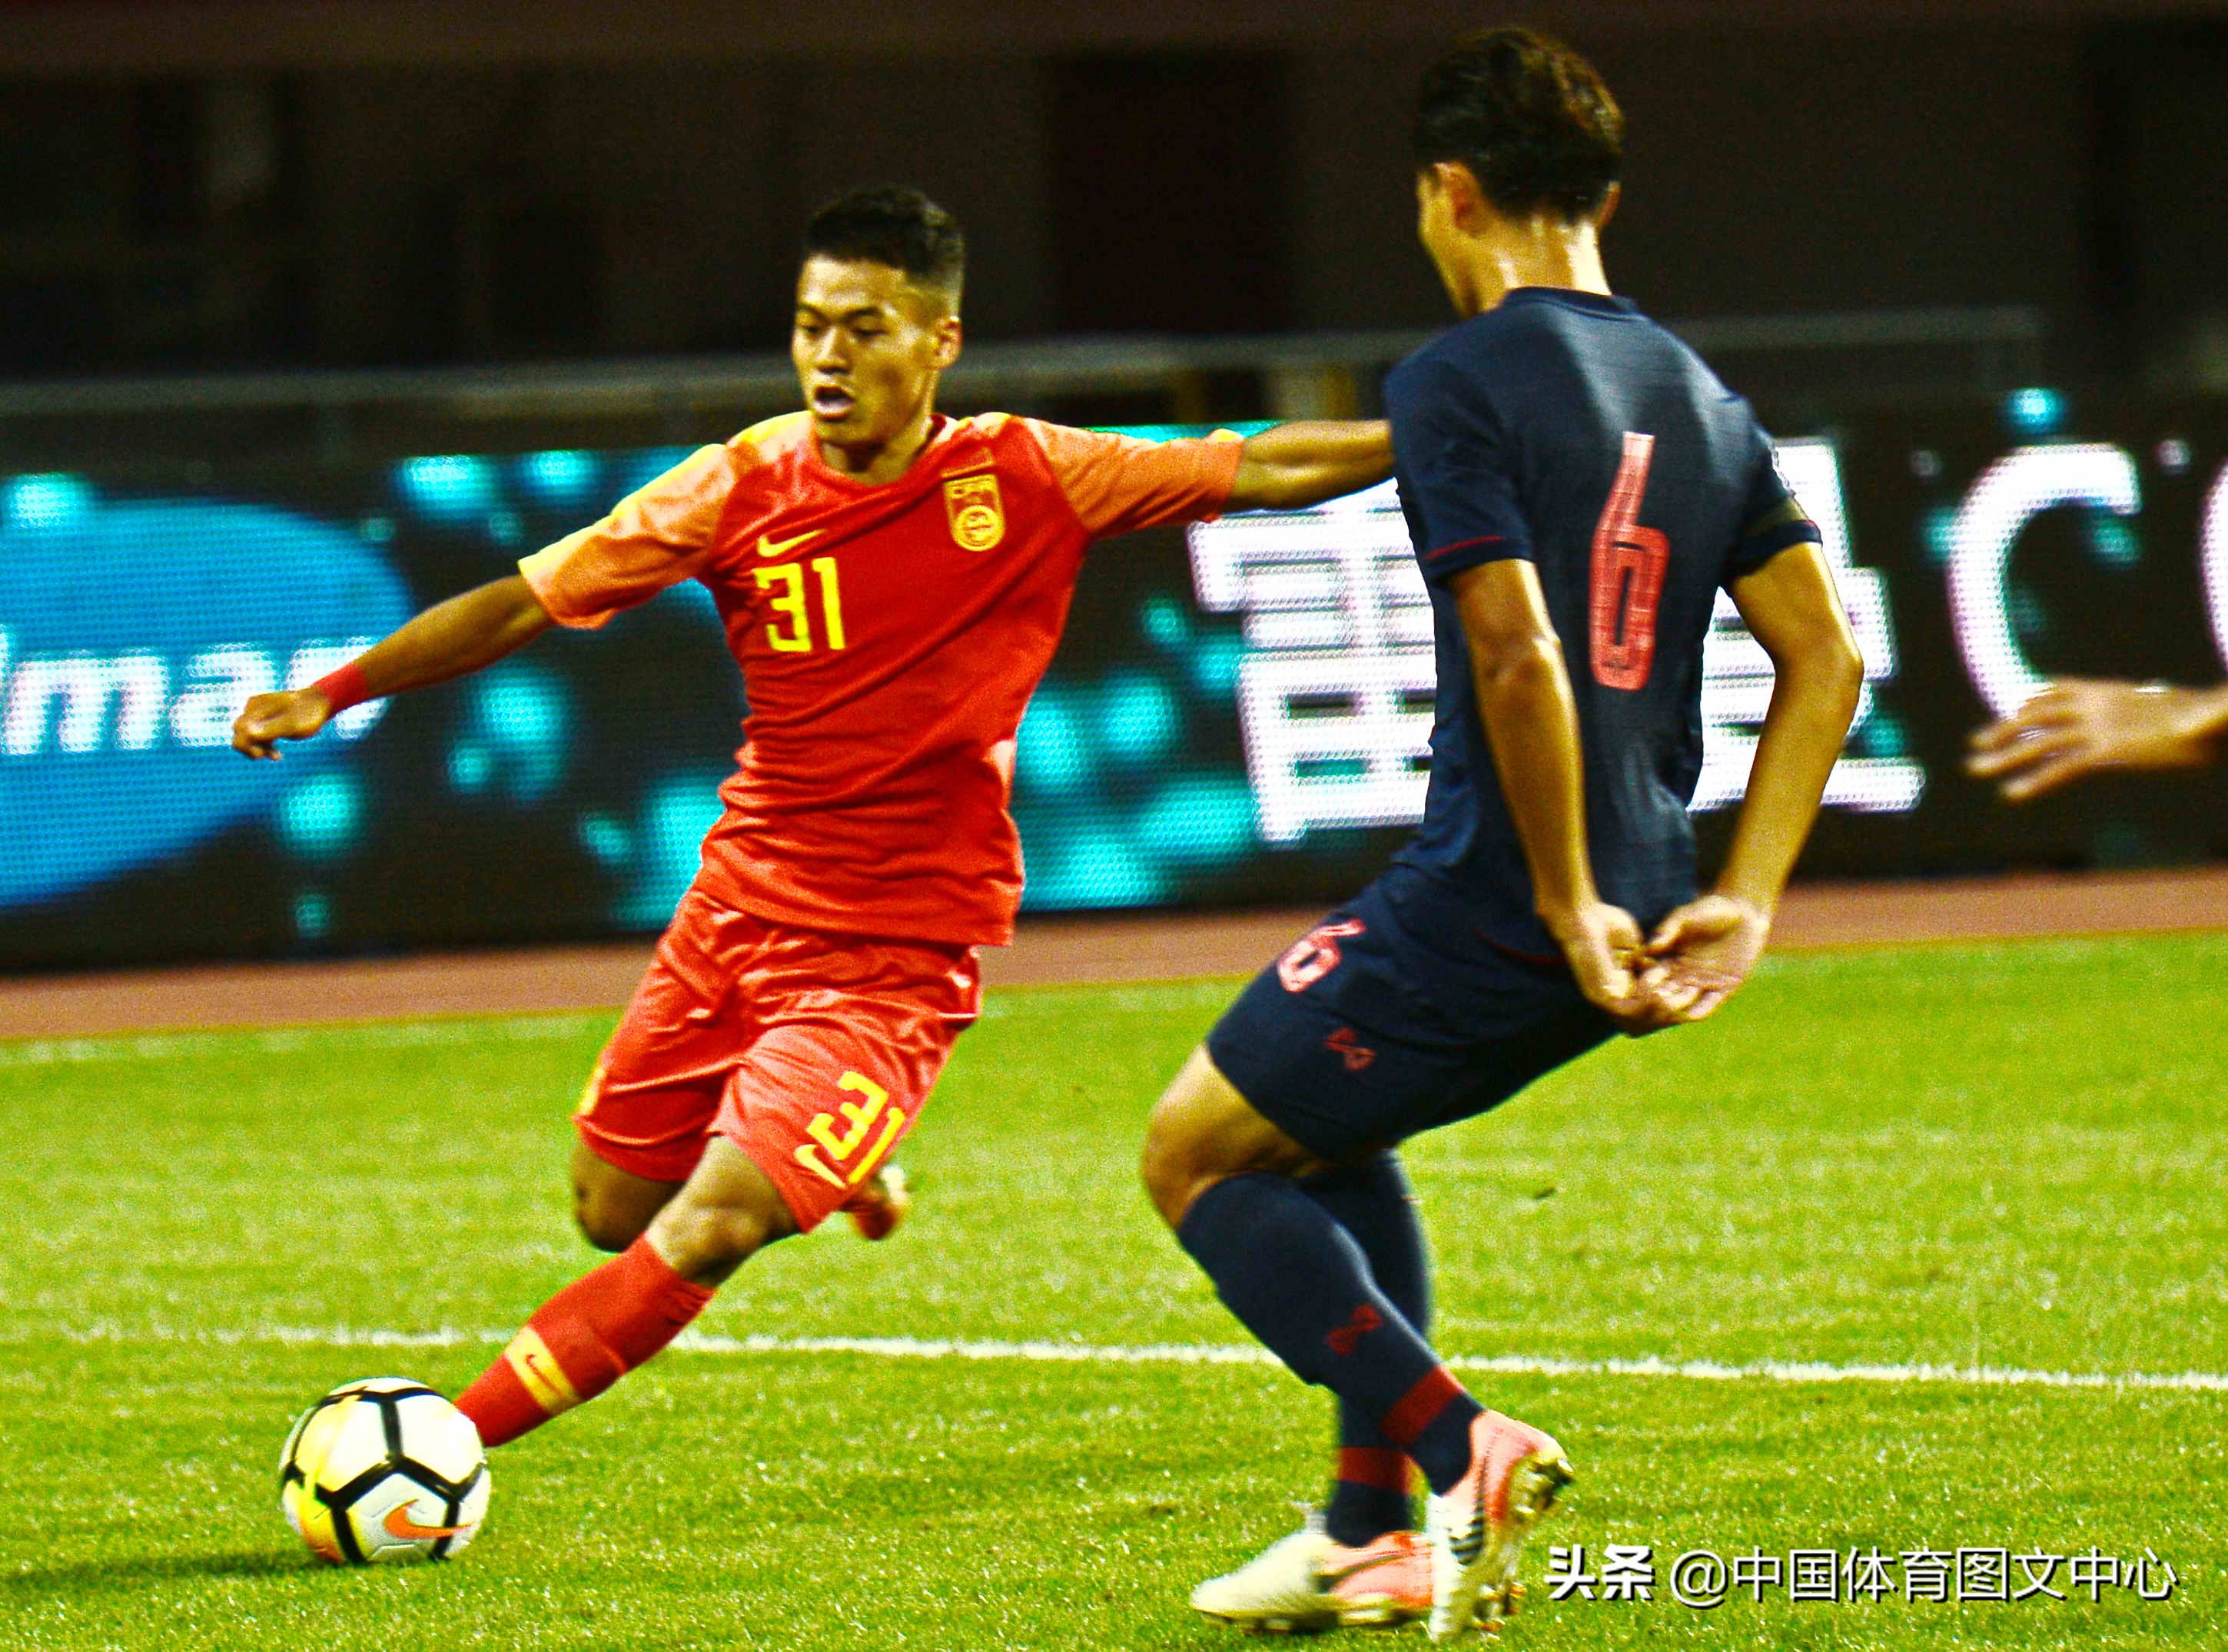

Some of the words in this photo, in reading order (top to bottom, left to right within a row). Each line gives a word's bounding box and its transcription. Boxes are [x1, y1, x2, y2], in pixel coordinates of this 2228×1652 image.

[752, 557, 845, 652] 31
[1589, 431, 1669, 691] 6
[1277, 917, 1366, 994] 6
[806, 1071, 905, 1184] 31
